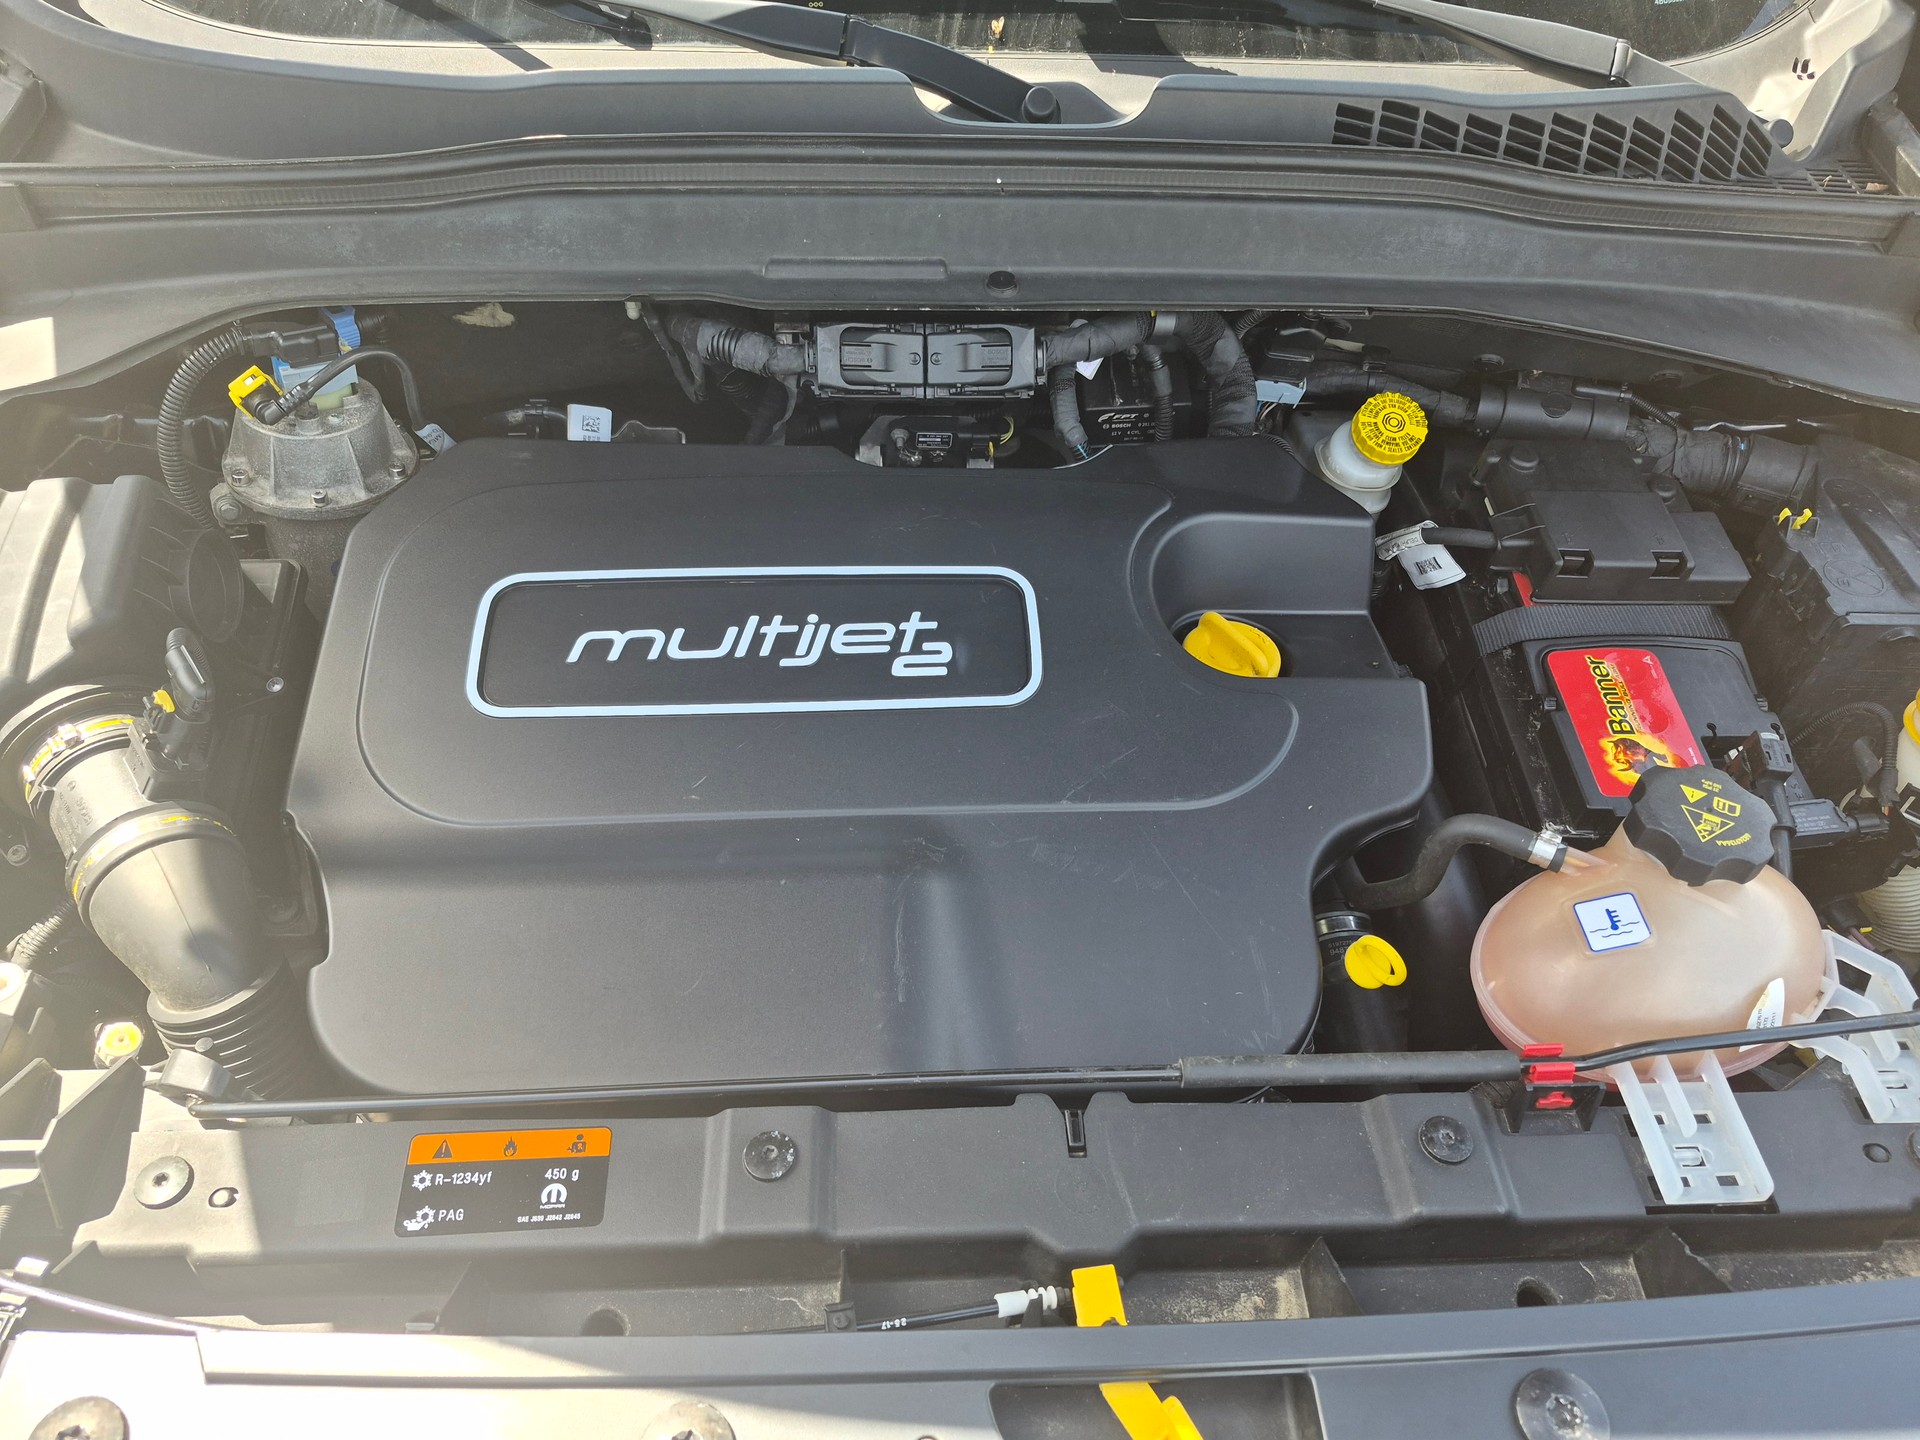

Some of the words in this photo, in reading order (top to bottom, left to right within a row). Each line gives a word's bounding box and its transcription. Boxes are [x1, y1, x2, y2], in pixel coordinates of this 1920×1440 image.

[566, 611, 938, 667] multijet
[1586, 655, 1636, 735] Banner
[434, 1171, 492, 1186] R-1234yf
[544, 1168, 566, 1180] 450
[572, 1169, 580, 1182] g
[438, 1209, 464, 1222] PAG
